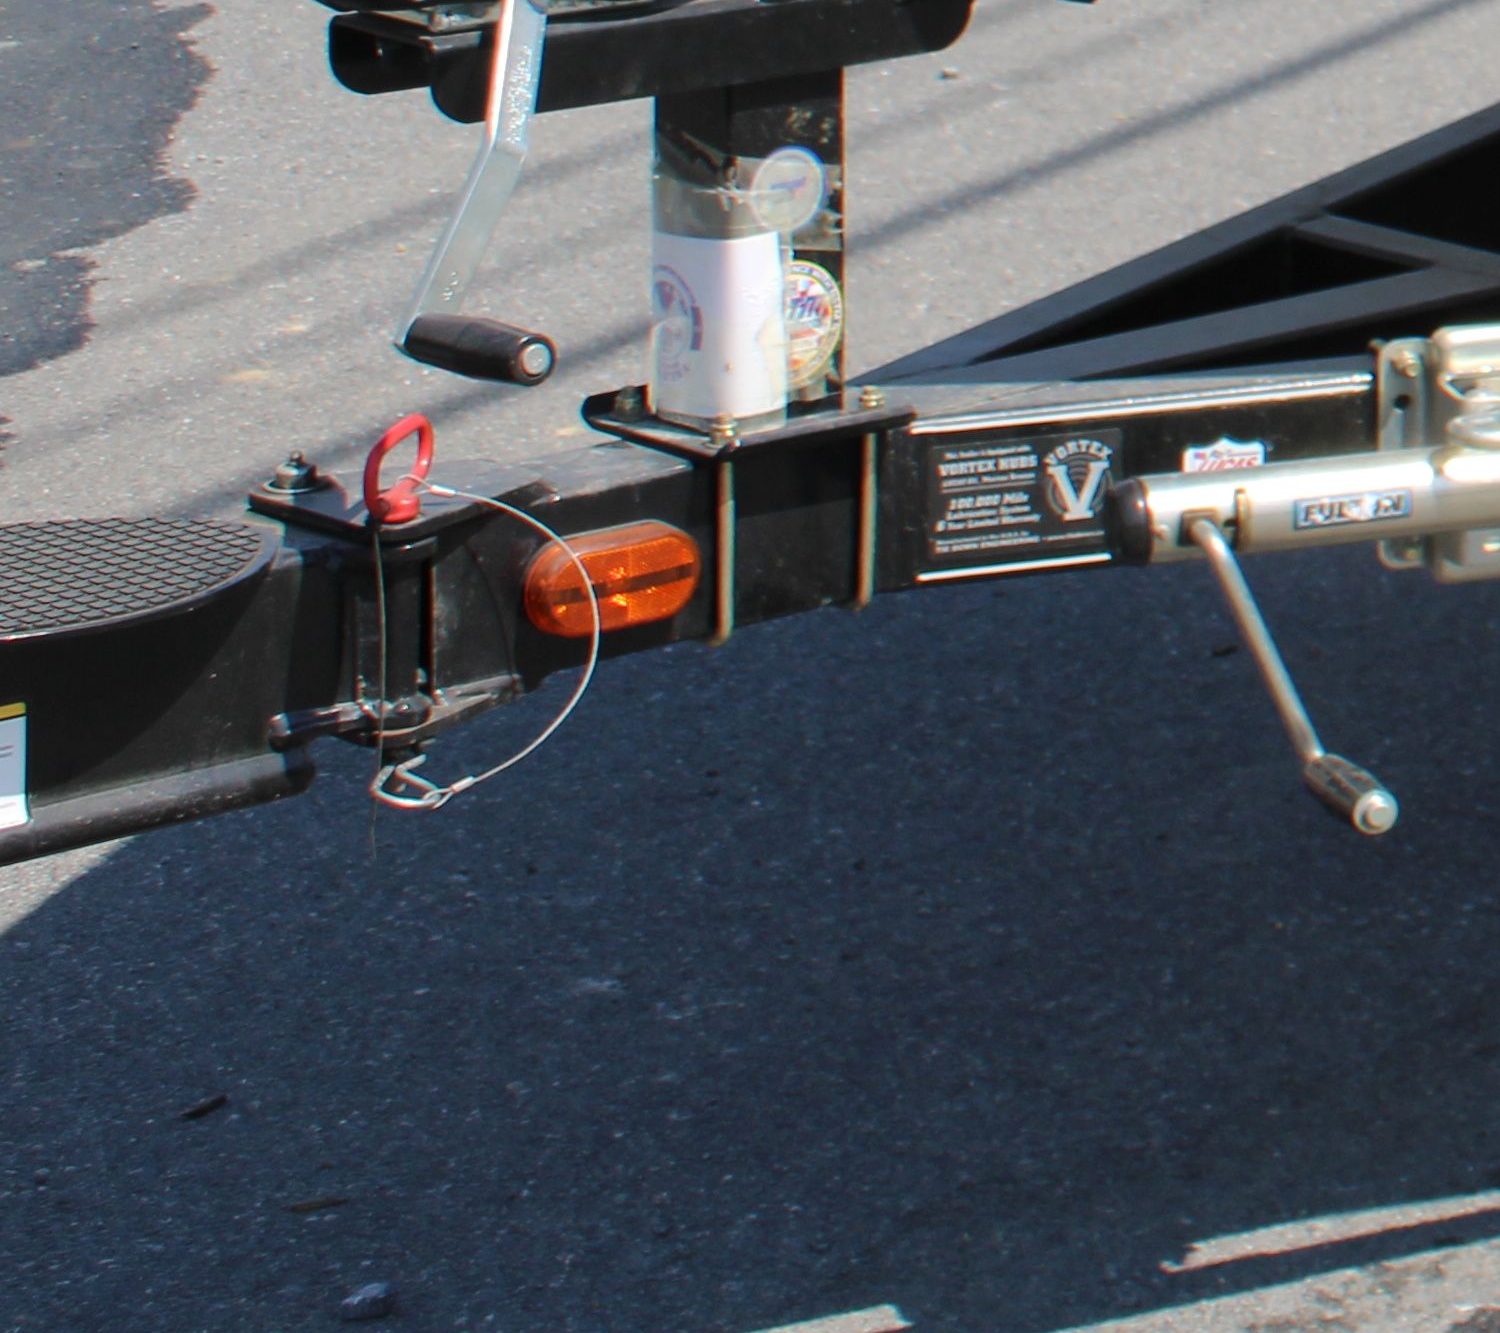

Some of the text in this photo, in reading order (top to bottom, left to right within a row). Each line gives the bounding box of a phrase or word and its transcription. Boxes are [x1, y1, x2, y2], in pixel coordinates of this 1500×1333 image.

[1042, 439, 1114, 465] VORTEX
[938, 454, 1038, 476] VORTEX HUBS
